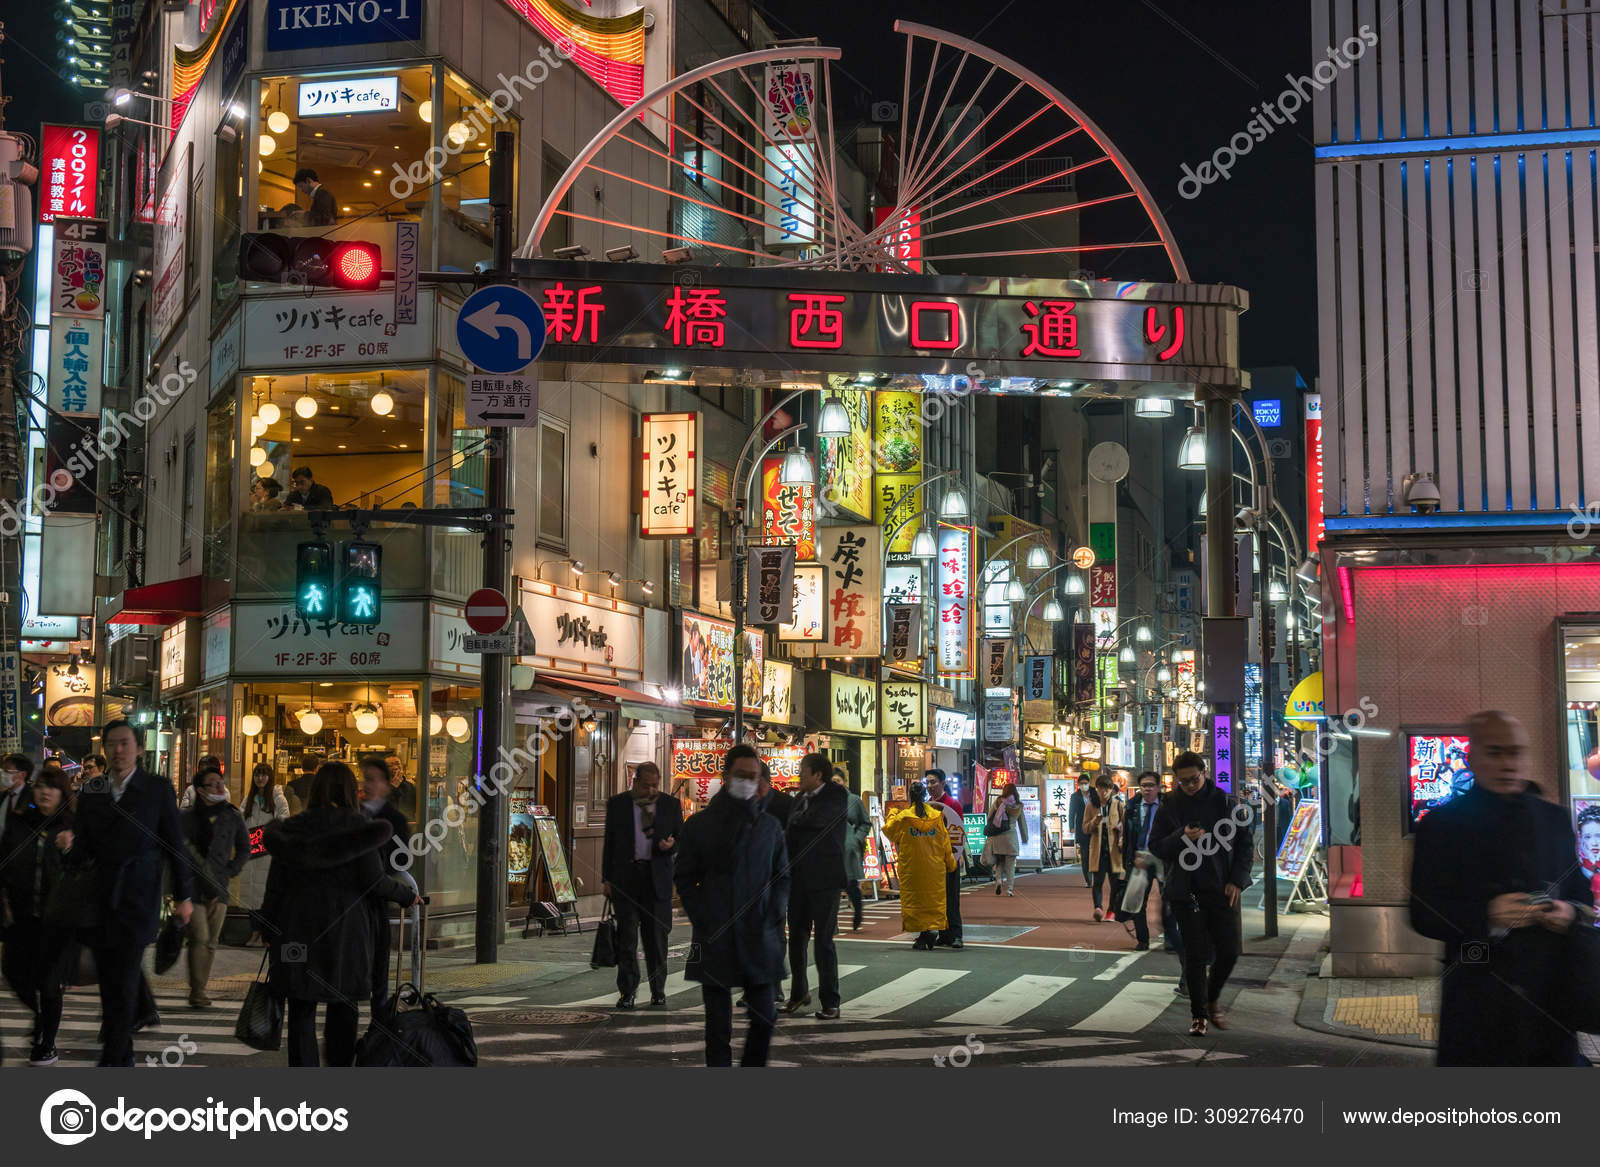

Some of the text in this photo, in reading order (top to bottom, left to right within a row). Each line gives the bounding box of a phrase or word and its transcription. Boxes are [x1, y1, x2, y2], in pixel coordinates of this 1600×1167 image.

[307, 87, 381, 107] ツバキ cafe
[50, 158, 66, 212] 美顔教室
[64, 224, 97, 239] 4F
[61, 247, 78, 309] オアシス
[400, 226, 416, 322] スクランブル式
[275, 305, 384, 333] ツバキ cafe
[543, 281, 1185, 361] 新橋西口通り
[358, 342, 388, 355] 60席
[62, 329, 90, 412] 個人輸入代行
[470, 380, 532, 393] 自転車を除く
[471, 395, 531, 408] 一方通行
[1255, 415, 1280, 423] STAY
[657, 433, 677, 498] ツバキ
[653, 501, 681, 515] cafe
[830, 531, 867, 650] 炭火焼肉
[1092, 567, 1103, 605] ラーメン
[350, 652, 381, 665] 60席
[899, 748, 924, 758] BAR
[1216, 726, 1229, 783] 共栄会
[1414, 740, 1437, 780] 新台
[963, 816, 985, 825] BAR
